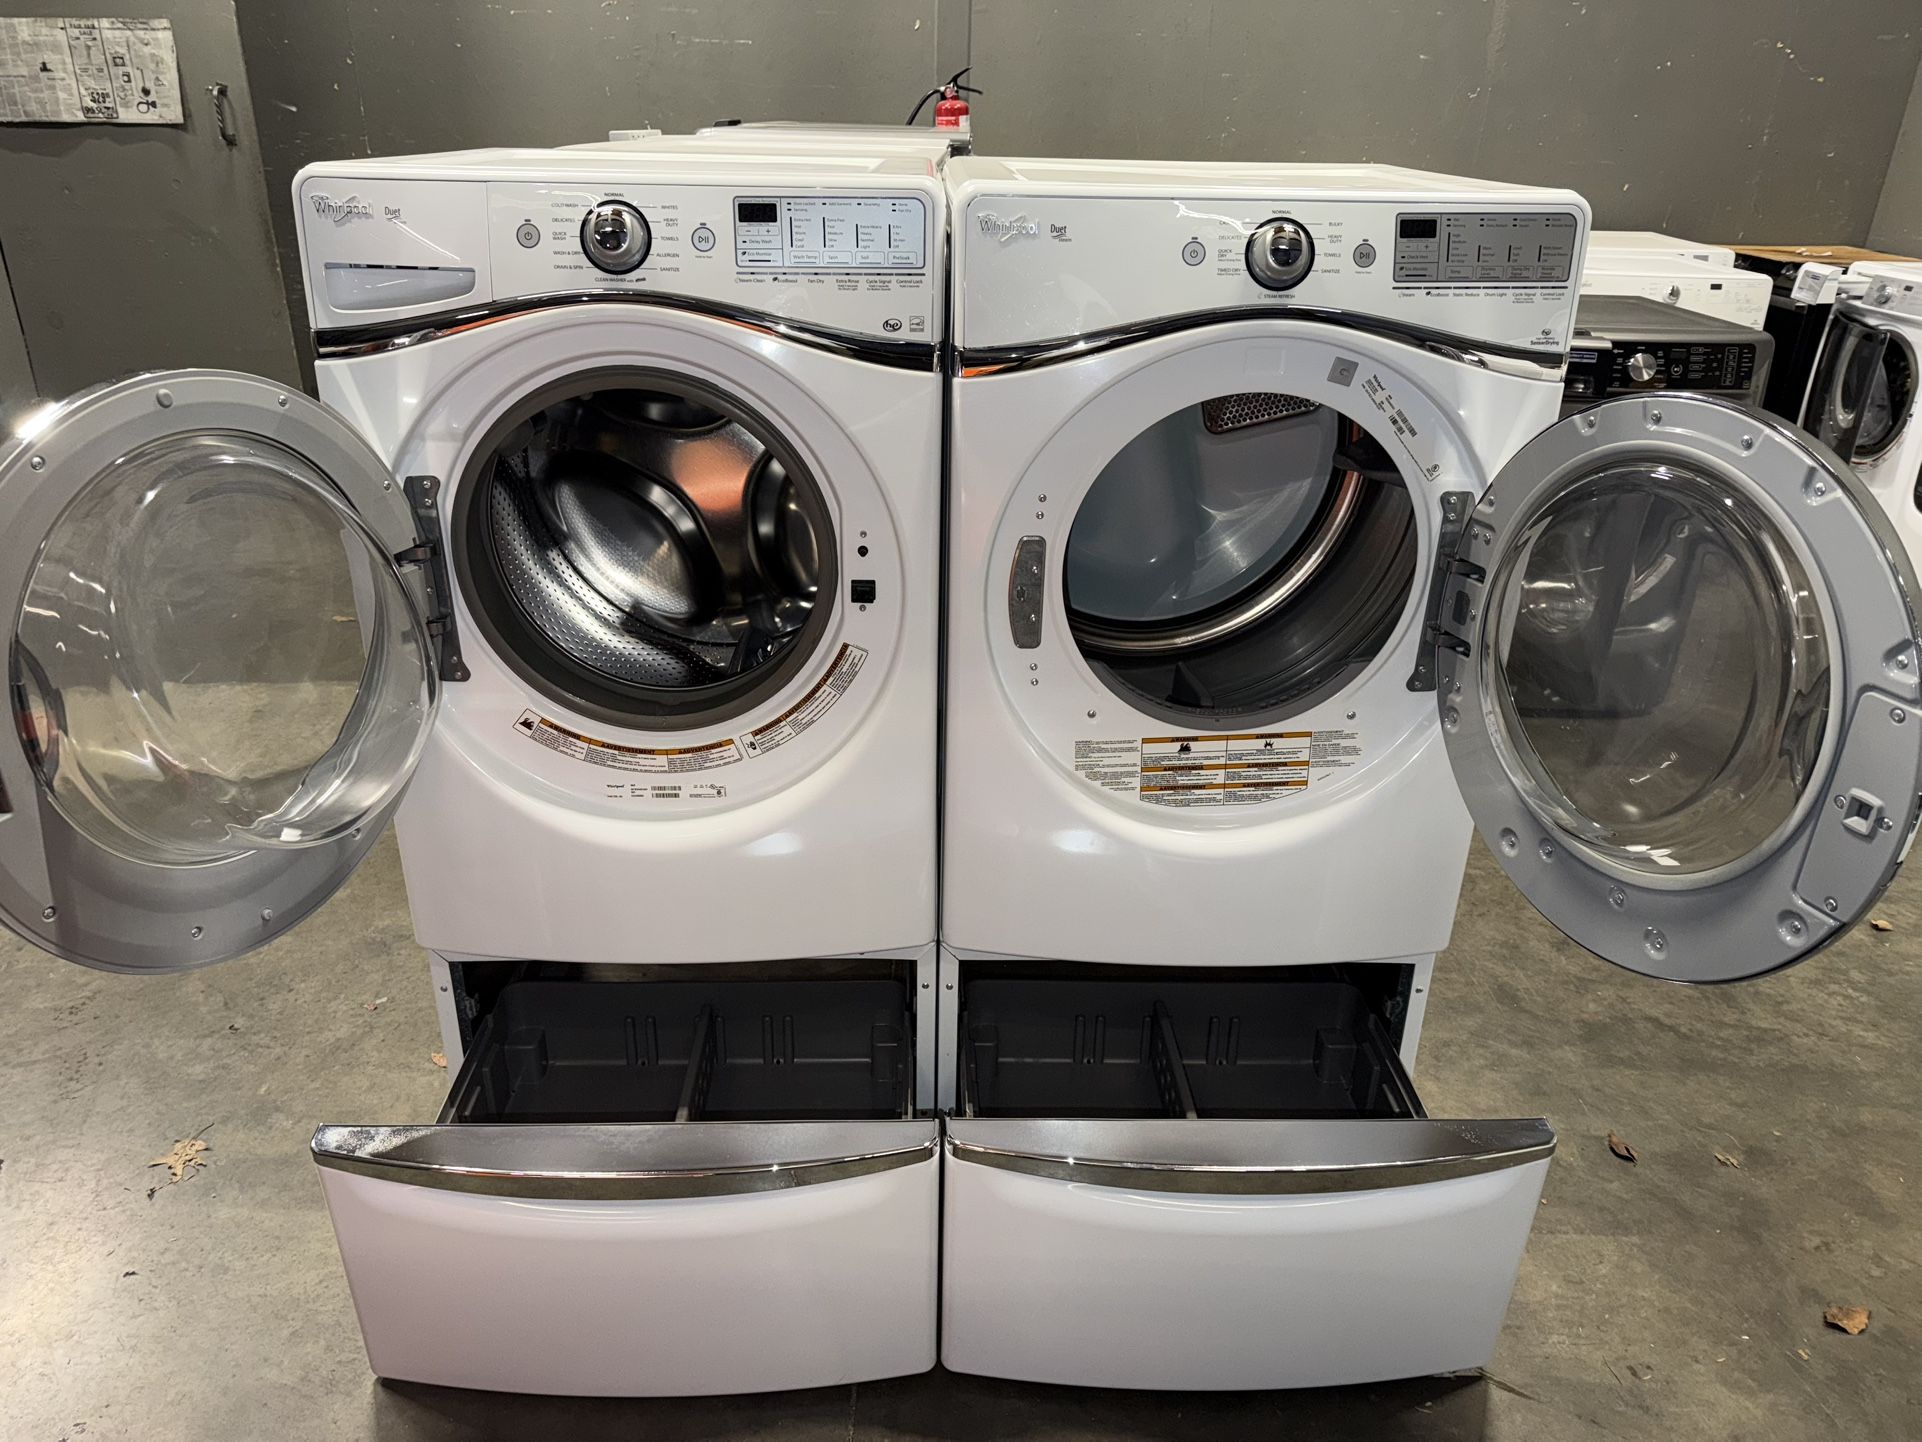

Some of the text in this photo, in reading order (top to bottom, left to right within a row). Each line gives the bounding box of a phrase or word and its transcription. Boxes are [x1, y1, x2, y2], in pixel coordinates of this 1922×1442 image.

[310, 195, 374, 222] Whirlpool
[384, 206, 401, 217] Duet
[978, 214, 1039, 241] Whirlpool
[1050, 223, 1067, 234] Duet
[553, 726, 581, 740] WARNING
[606, 743, 656, 755] AVERTISSEMENT
[682, 742, 723, 754] ADVERTENCIA
[1163, 784, 1206, 792] AVERTISSEMENT
